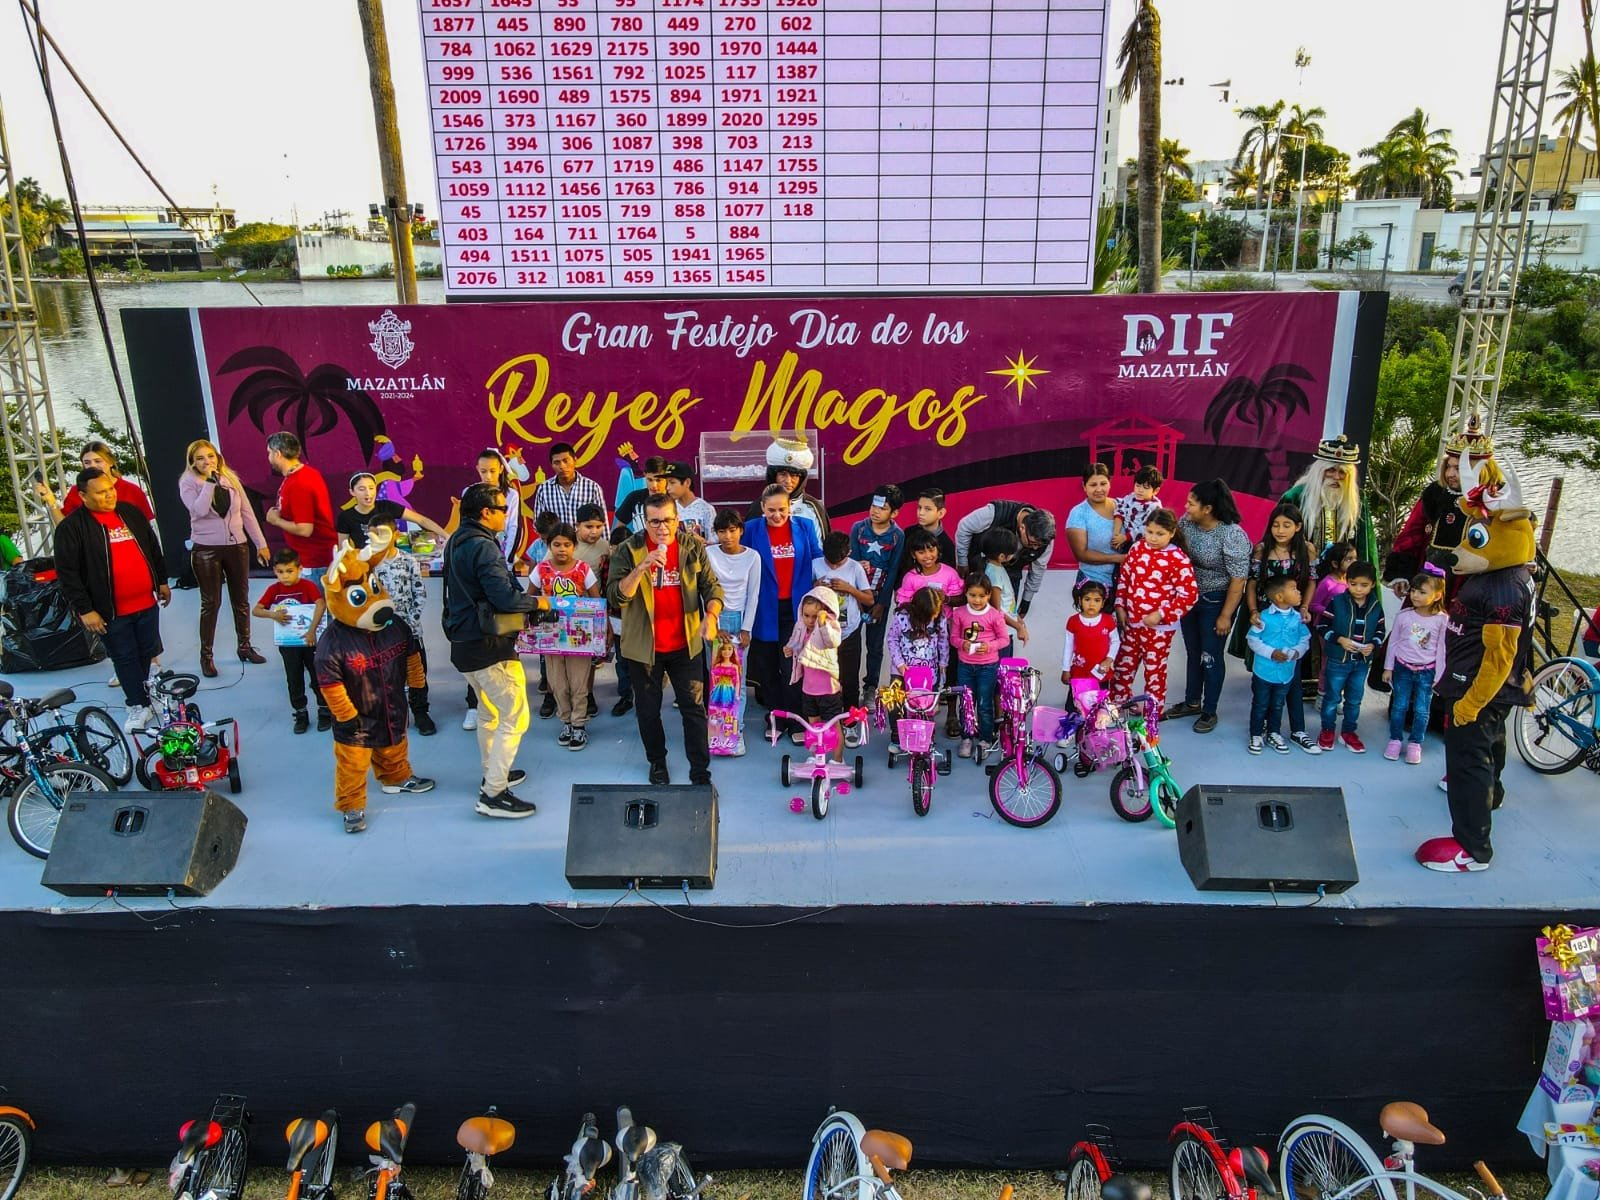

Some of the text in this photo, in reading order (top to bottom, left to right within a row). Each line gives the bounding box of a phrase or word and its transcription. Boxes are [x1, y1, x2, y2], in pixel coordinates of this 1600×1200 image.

[434, 15, 813, 33] 1877 445 890 780 449 270 602
[442, 40, 818, 57] 784 1062 1629 2175 390 1970 1444
[442, 64, 817, 81] 999 536 1561 792 1025 117 1387
[440, 88, 817, 105] 2009 1690 489 1575 894 1971 1921
[443, 111, 818, 129] 1546 373 1167 360 1899 2020 1295
[446, 134, 813, 151] 1726 394 306 1087 398 703 213
[451, 158, 817, 175] 543 1476 677 1719 486 1147 1755
[450, 180, 818, 197] 1059 1112 1456 1763 786 914 1295
[460, 202, 814, 219] 45 1257 1105 719 858 1077 118
[458, 225, 760, 242] 403 164 711 1764 5 884
[460, 247, 765, 263] 494 1511 1075 505 1941 1965
[457, 269, 766, 285] 2076 312 1081 459 1365 1545
[562, 307, 970, 358] Gran Festejo Día de los
[1121, 312, 1234, 357] DIF
[1117, 358, 1230, 378] MAZATLÁN
[346, 373, 446, 391] MAZATLÁN
[380, 392, 415, 400] 2021-2024
[485, 349, 987, 468] Reyes Magos
[1572, 940, 1588, 952] 183
[1561, 1134, 1584, 1144] 171
